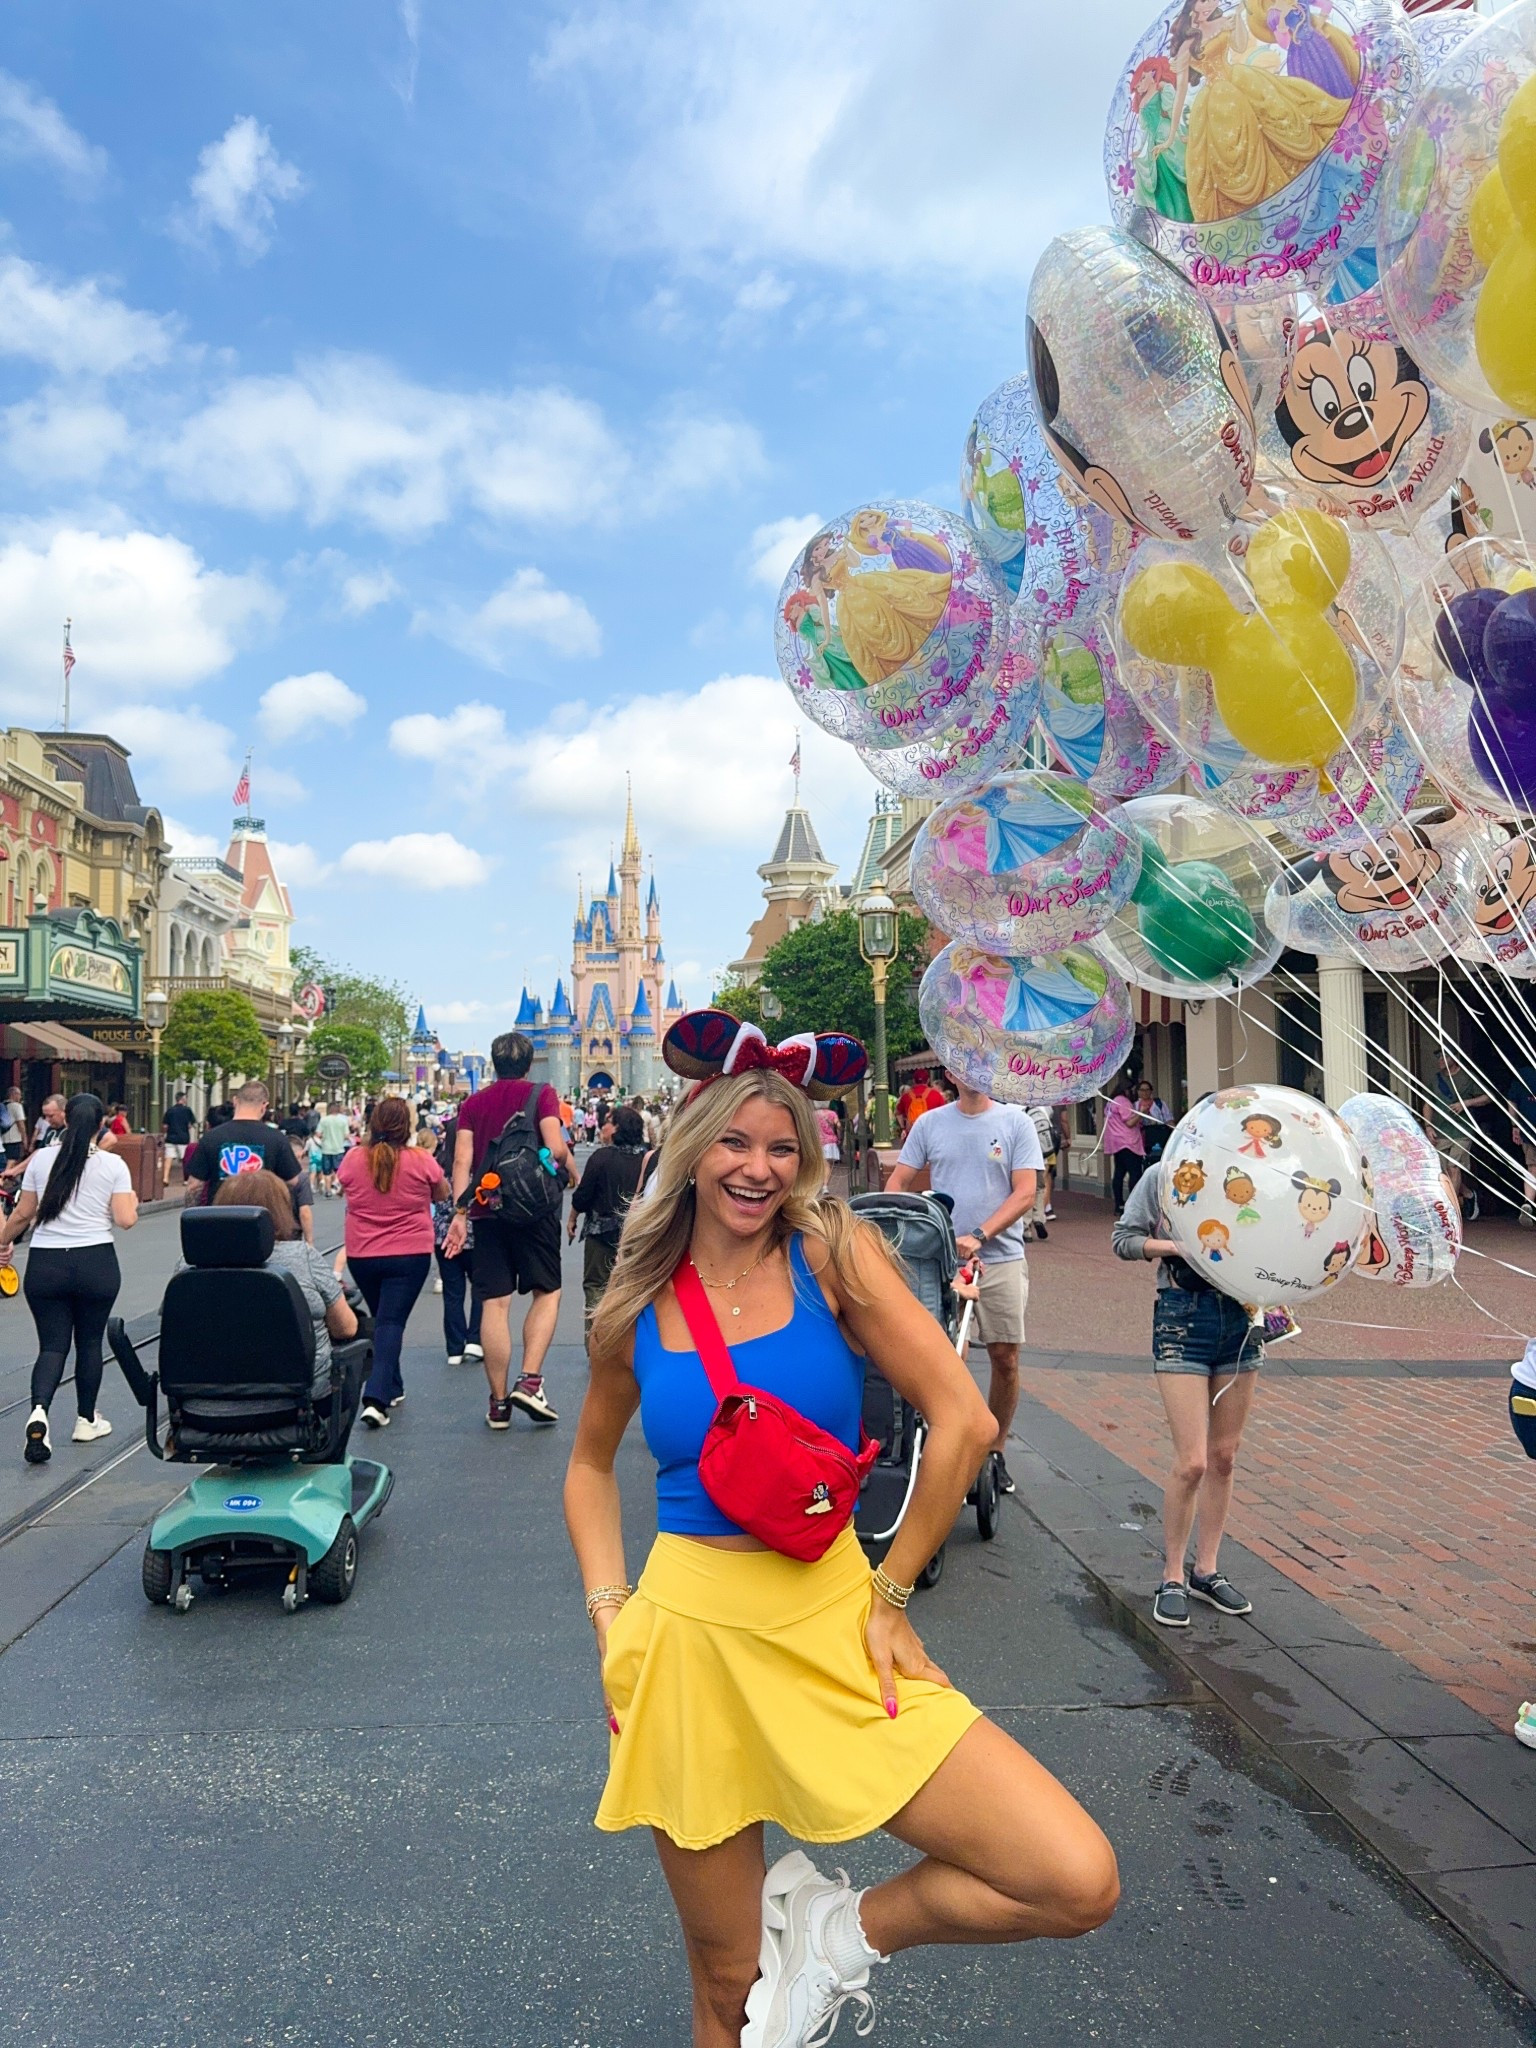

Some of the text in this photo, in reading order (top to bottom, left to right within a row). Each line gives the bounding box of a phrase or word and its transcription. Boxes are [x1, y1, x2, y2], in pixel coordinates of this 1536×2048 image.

[1336, 153, 1385, 222] World
[972, 600, 993, 652] World
[93, 1030, 149, 1041] HOUSE OF
[221, 1145, 251, 1176] VP
